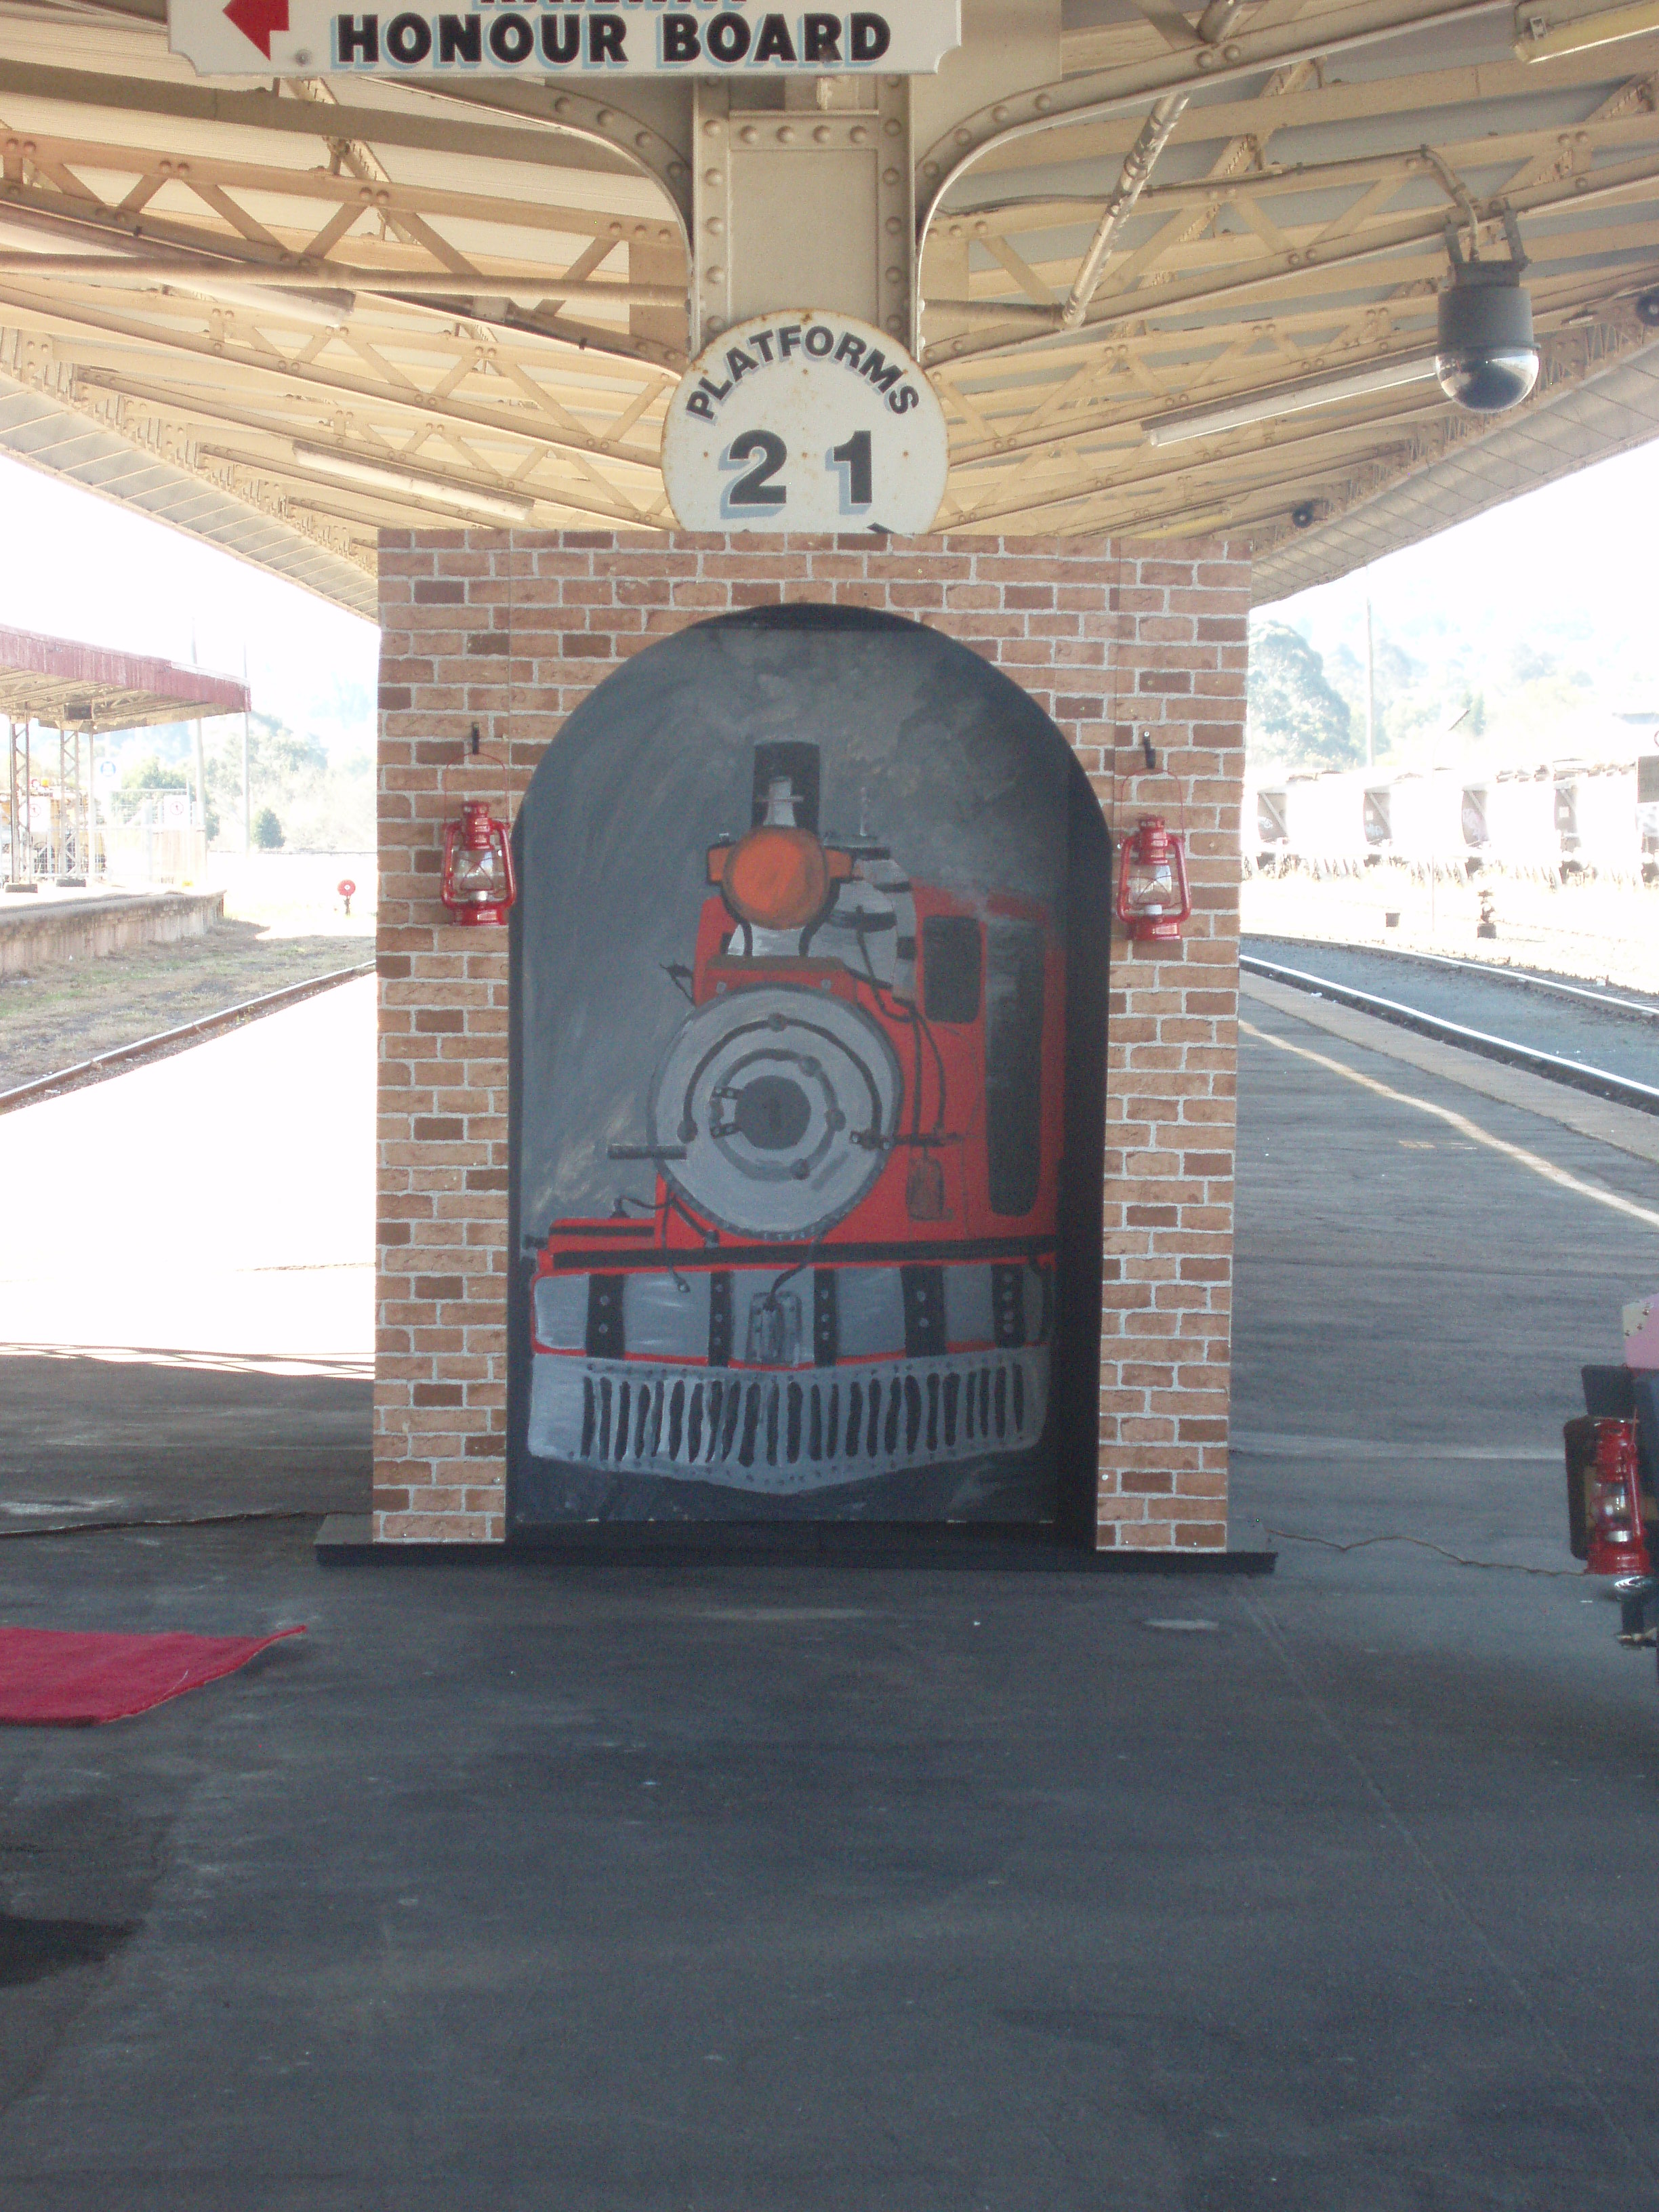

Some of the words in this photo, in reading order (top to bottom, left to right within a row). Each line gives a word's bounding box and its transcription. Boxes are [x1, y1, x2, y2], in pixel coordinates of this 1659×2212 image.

[337, 12, 630, 64] HONOUR
[661, 11, 891, 63] BOARD
[685, 325, 920, 420] PLATFORMS
[727, 428, 788, 506] 2
[833, 429, 873, 504] 1
